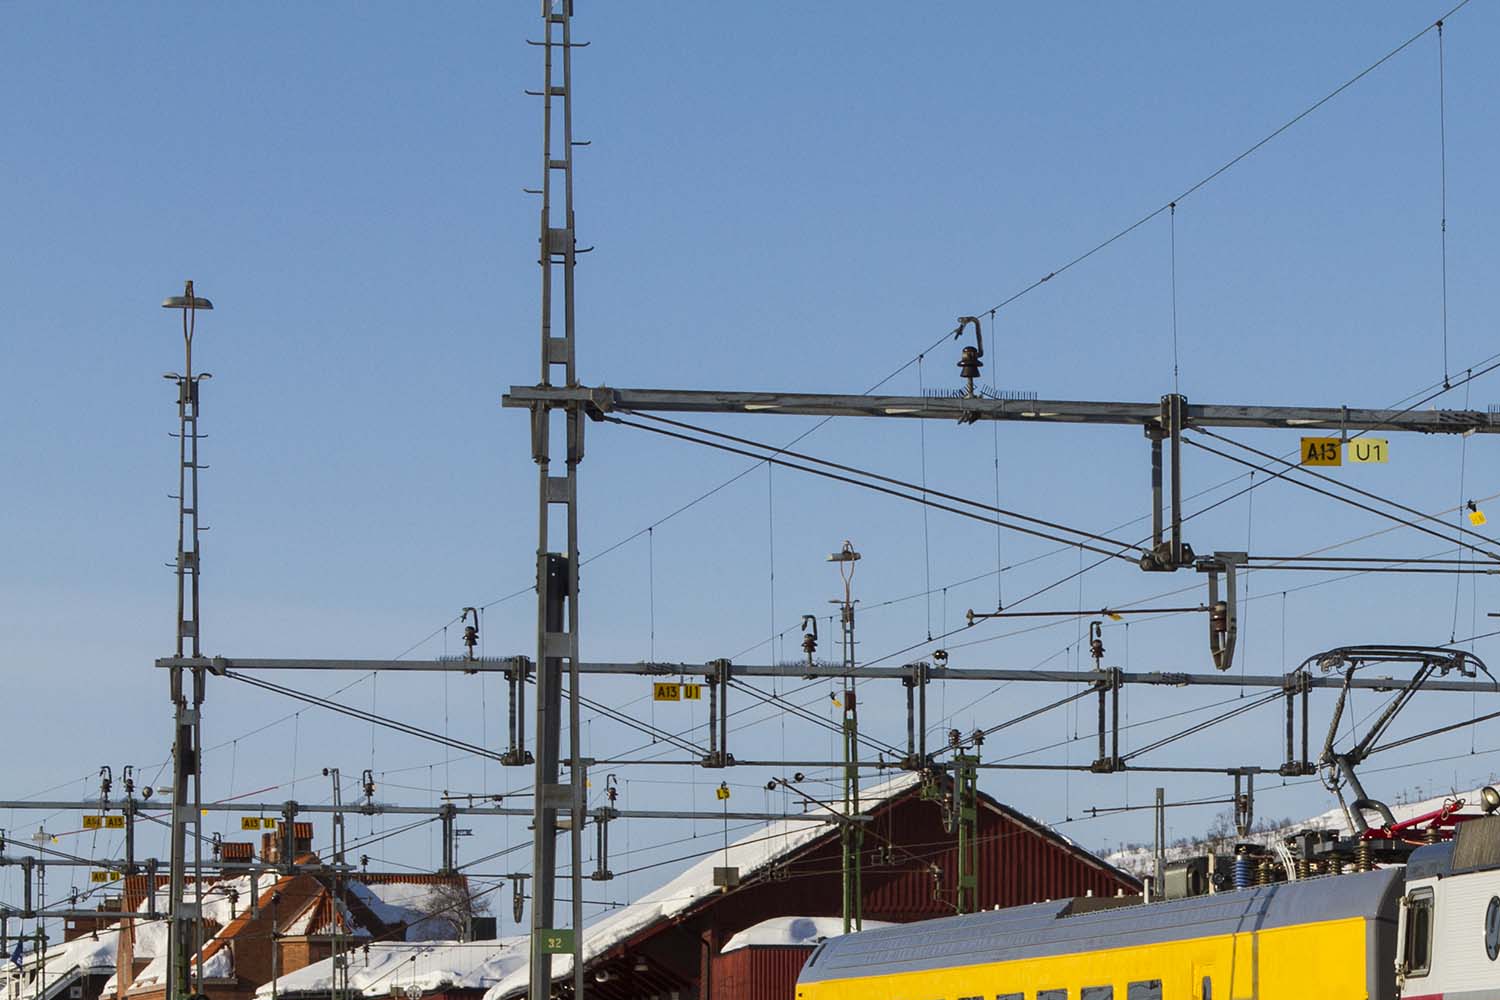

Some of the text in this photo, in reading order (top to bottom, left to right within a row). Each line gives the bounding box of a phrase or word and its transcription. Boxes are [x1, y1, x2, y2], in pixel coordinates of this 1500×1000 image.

[1306, 442, 1381, 461] A13 U1
[657, 686, 699, 699] A13 U1
[547, 937, 562, 949] 32
